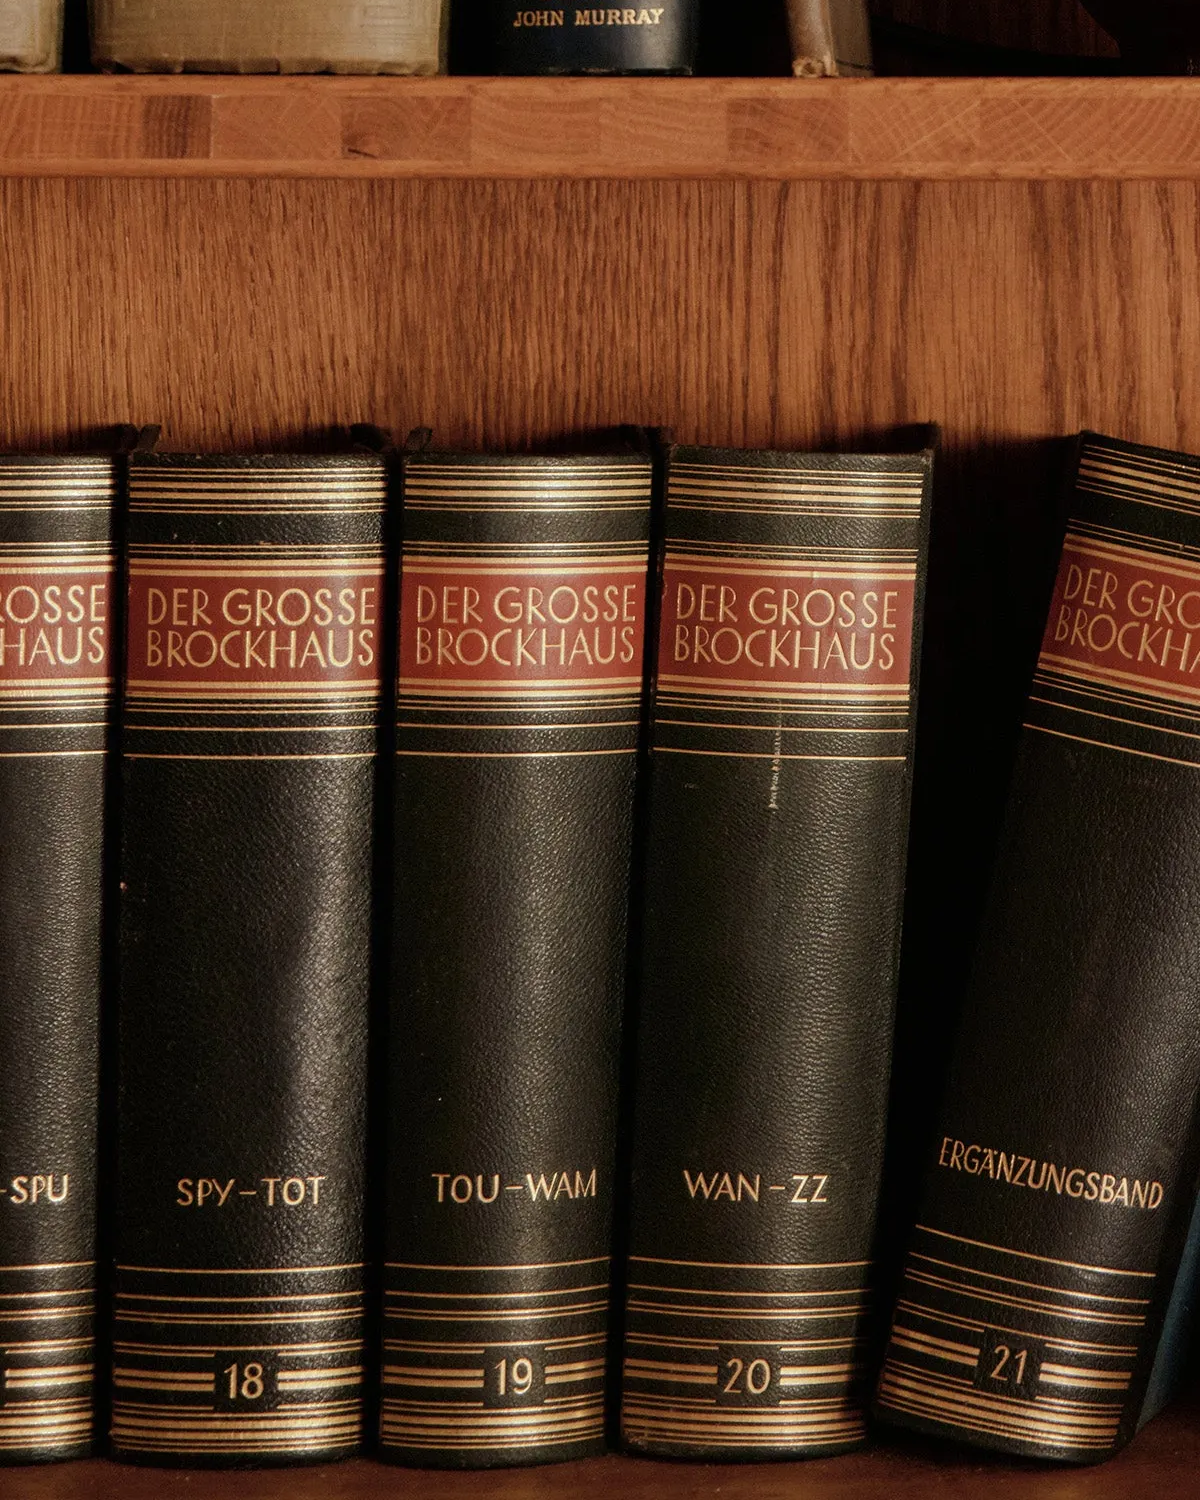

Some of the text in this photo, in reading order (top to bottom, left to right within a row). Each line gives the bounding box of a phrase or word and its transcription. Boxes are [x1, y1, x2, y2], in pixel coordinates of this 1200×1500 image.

[513, 8, 664, 27] JOHN MURRAY
[0, 584, 106, 624] OSSE
[147, 586, 376, 627] DER GROSSE
[416, 583, 637, 624] DER GROSSE
[676, 582, 898, 629] DER GROSSE
[1063, 564, 1118, 610] DER
[146, 629, 375, 669] BROCKHAUS
[416, 625, 636, 667] BROCKHAUS
[674, 623, 896, 671] BROCKHAUS
[938, 1136, 1164, 1210] ERGÄNZUNGSBAND
[223, 1362, 265, 1400] 18
[493, 1357, 534, 1396] 19
[723, 1357, 771, 1395] 20
[989, 1344, 1027, 1385] 21
